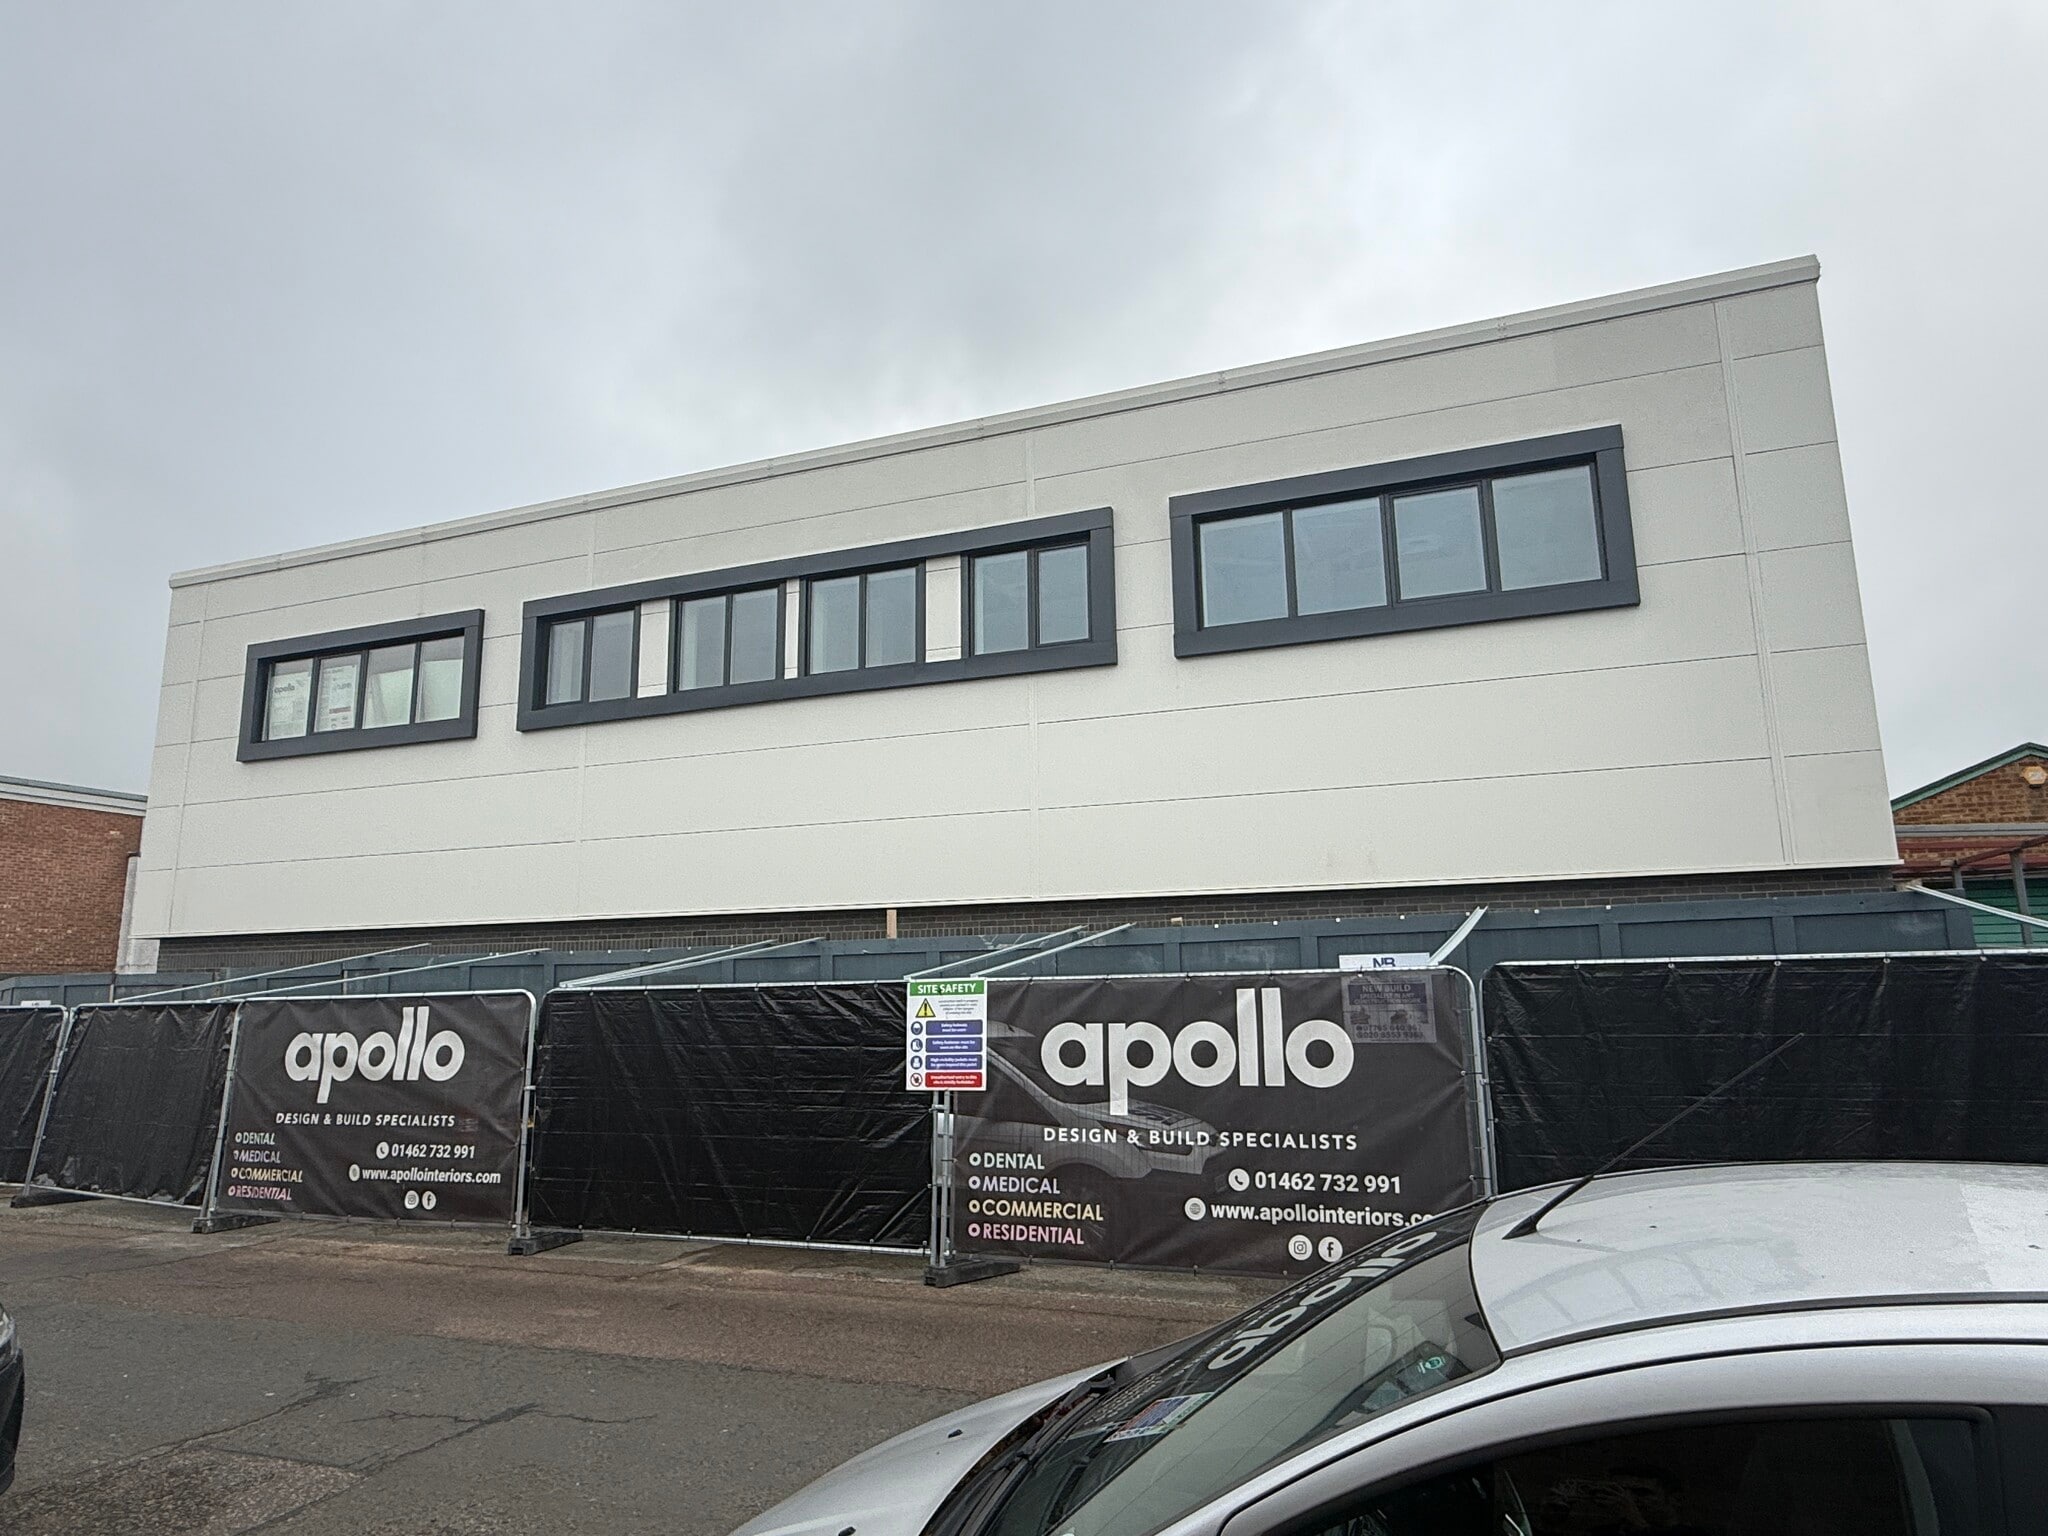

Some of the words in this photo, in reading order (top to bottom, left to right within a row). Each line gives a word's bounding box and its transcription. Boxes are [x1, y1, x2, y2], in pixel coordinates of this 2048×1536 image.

[917, 984, 938, 994] SITE
[940, 983, 976, 993] SAFETY
[285, 1006, 465, 1103] apollo
[1040, 987, 1354, 1116] apollo
[276, 1112, 319, 1125] DESIGN
[323, 1113, 331, 1125] &
[336, 1114, 371, 1126] BUILD
[375, 1114, 455, 1126] SPECIALISTS
[243, 1131, 275, 1145] DENTAL
[1043, 1127, 1117, 1144] DESIGN
[1127, 1128, 1141, 1145] &
[1149, 1130, 1211, 1147] BUILD
[1219, 1131, 1358, 1150] SPECIALISTS
[238, 1150, 281, 1163] MEDICAL
[391, 1143, 427, 1158] 01462
[429, 1144, 451, 1158] 732
[453, 1144, 475, 1159] 991
[983, 1152, 1045, 1170] DENTAL
[238, 1167, 303, 1182] COMMERCIAL
[362, 1167, 501, 1184] www.apollointeriors.com
[1255, 1171, 1316, 1191] 01462
[1320, 1173, 1359, 1193] 732
[1364, 1175, 1401, 1194] 991
[235, 1186, 291, 1200] RESIDENTIAL
[982, 1176, 1060, 1194] MEDICAL
[982, 1199, 1104, 1221] COMMERCIAL
[983, 1223, 1084, 1245] RESIDENTIAL
